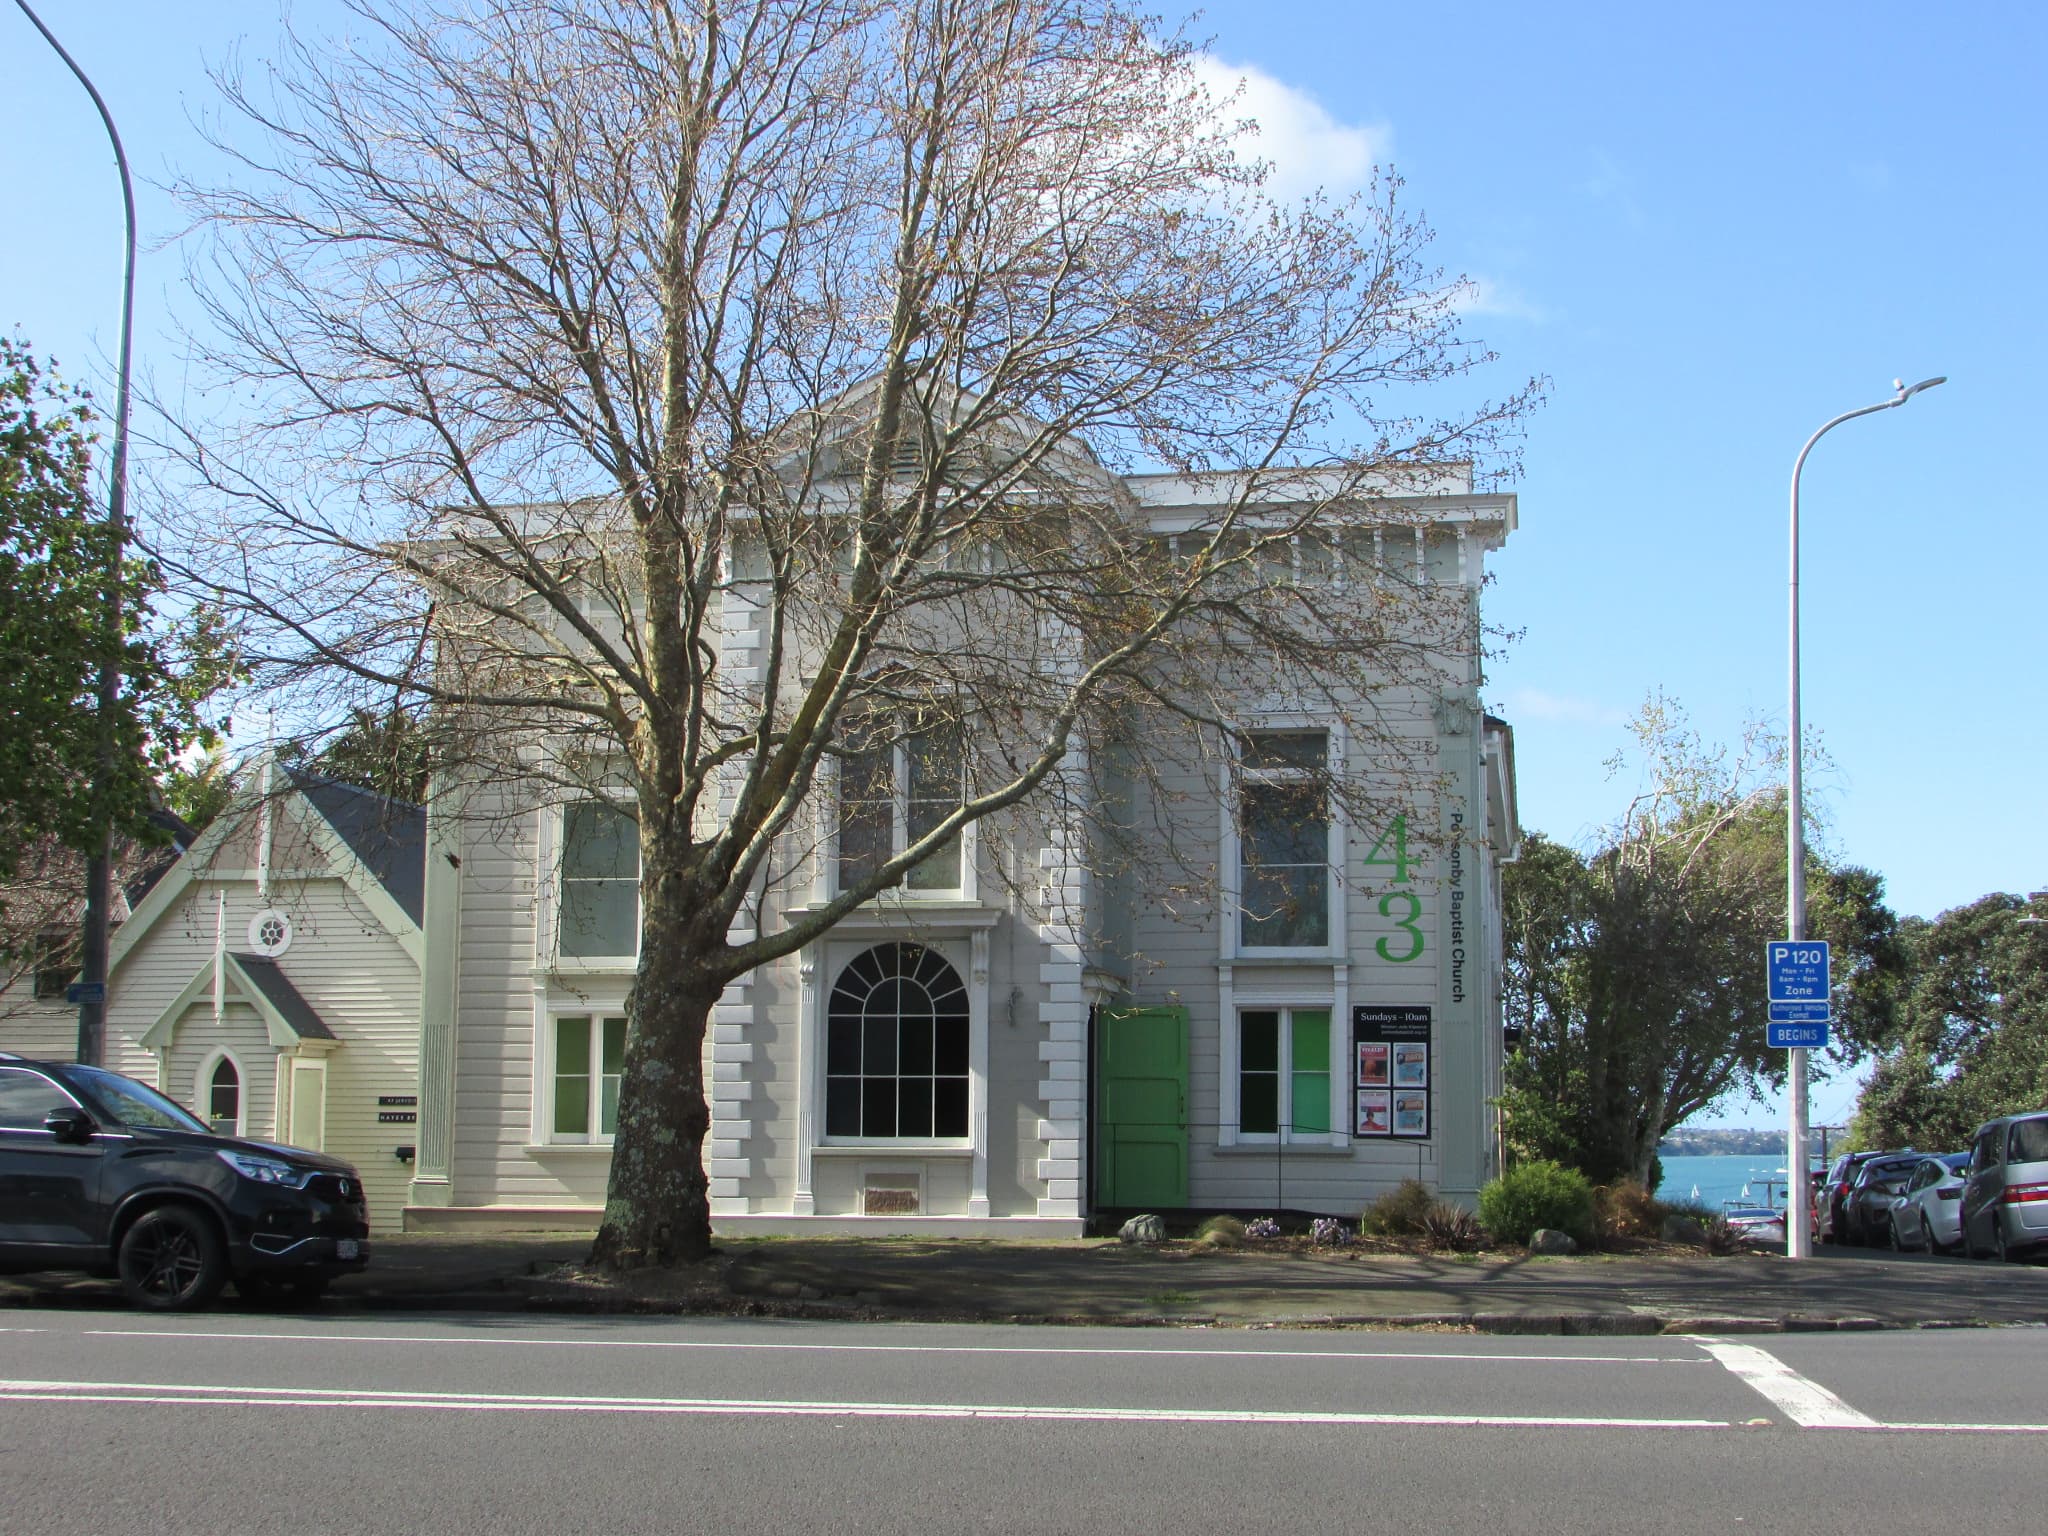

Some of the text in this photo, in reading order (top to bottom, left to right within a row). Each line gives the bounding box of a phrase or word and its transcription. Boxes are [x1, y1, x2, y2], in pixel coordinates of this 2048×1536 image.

[1449, 891, 1465, 945] Baptist
[1775, 948, 1821, 964] P 120
[1452, 948, 1466, 1003] Church
[1785, 985, 1813, 995] Zone
[1360, 1012, 1397, 1022] Sundays
[1405, 1012, 1428, 1021] 10am
[1778, 1029, 1818, 1041] BEGINS
